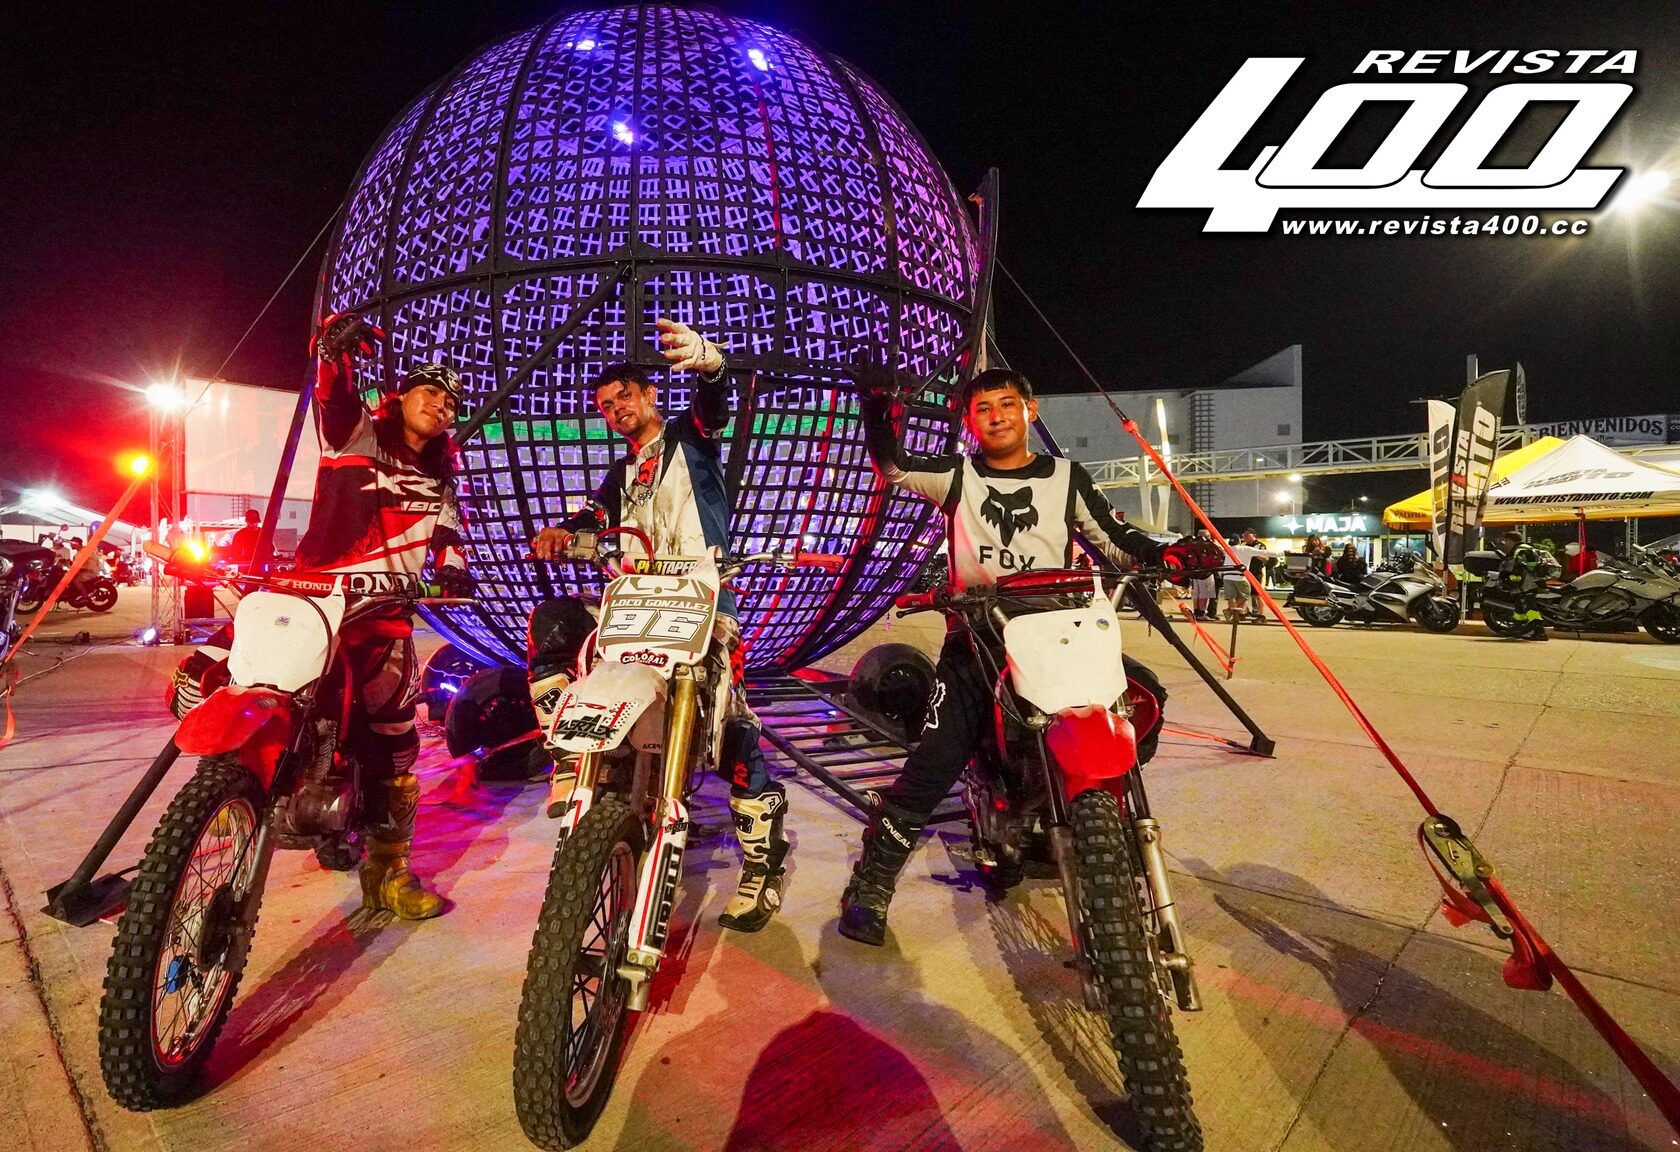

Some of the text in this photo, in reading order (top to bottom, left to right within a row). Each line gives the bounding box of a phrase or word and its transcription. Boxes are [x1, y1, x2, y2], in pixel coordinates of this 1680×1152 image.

[1539, 417, 1663, 436] BIENVENIDOS
[1450, 429, 1471, 536] REVISTA
[1494, 491, 1654, 505] WWW.REVISTAMOTO.COM
[1306, 517, 1367, 533] MAJA
[979, 545, 1035, 571] FOX
[292, 579, 333, 592] HOND
[610, 599, 712, 613] LOCO GONZALEZ
[600, 608, 710, 642] 96
[622, 653, 665, 665] COLOSAL
[881, 817, 911, 849] ONEAL
